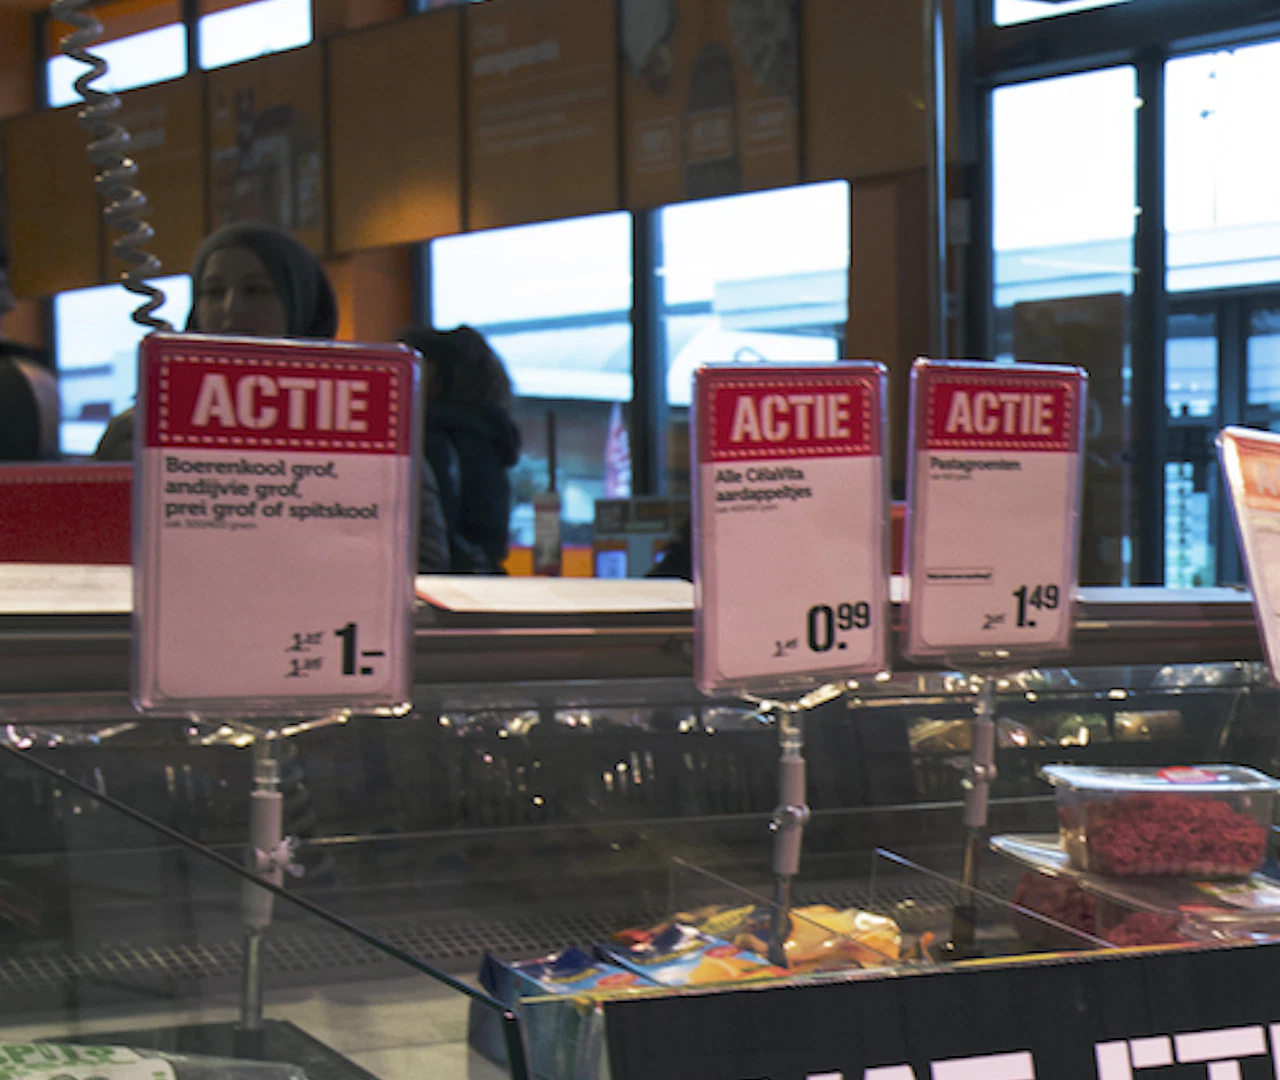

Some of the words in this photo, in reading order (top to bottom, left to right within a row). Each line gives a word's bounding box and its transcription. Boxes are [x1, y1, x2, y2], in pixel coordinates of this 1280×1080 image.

[190, 373, 370, 433] ACTIE
[729, 392, 852, 443] ACTIE
[945, 390, 1055, 436] ACTIE
[165, 456, 286, 476] Boerenkool
[291, 461, 339, 481] grof,
[165, 478, 249, 499] andijvie
[715, 469, 743, 483] Alle
[165, 499, 207, 518] prei
[212, 501, 257, 521] grof
[262, 502, 284, 517] of
[289, 502, 379, 521] spitskool
[806, 601, 872, 655] 0.99
[1013, 583, 1061, 629] 1.49
